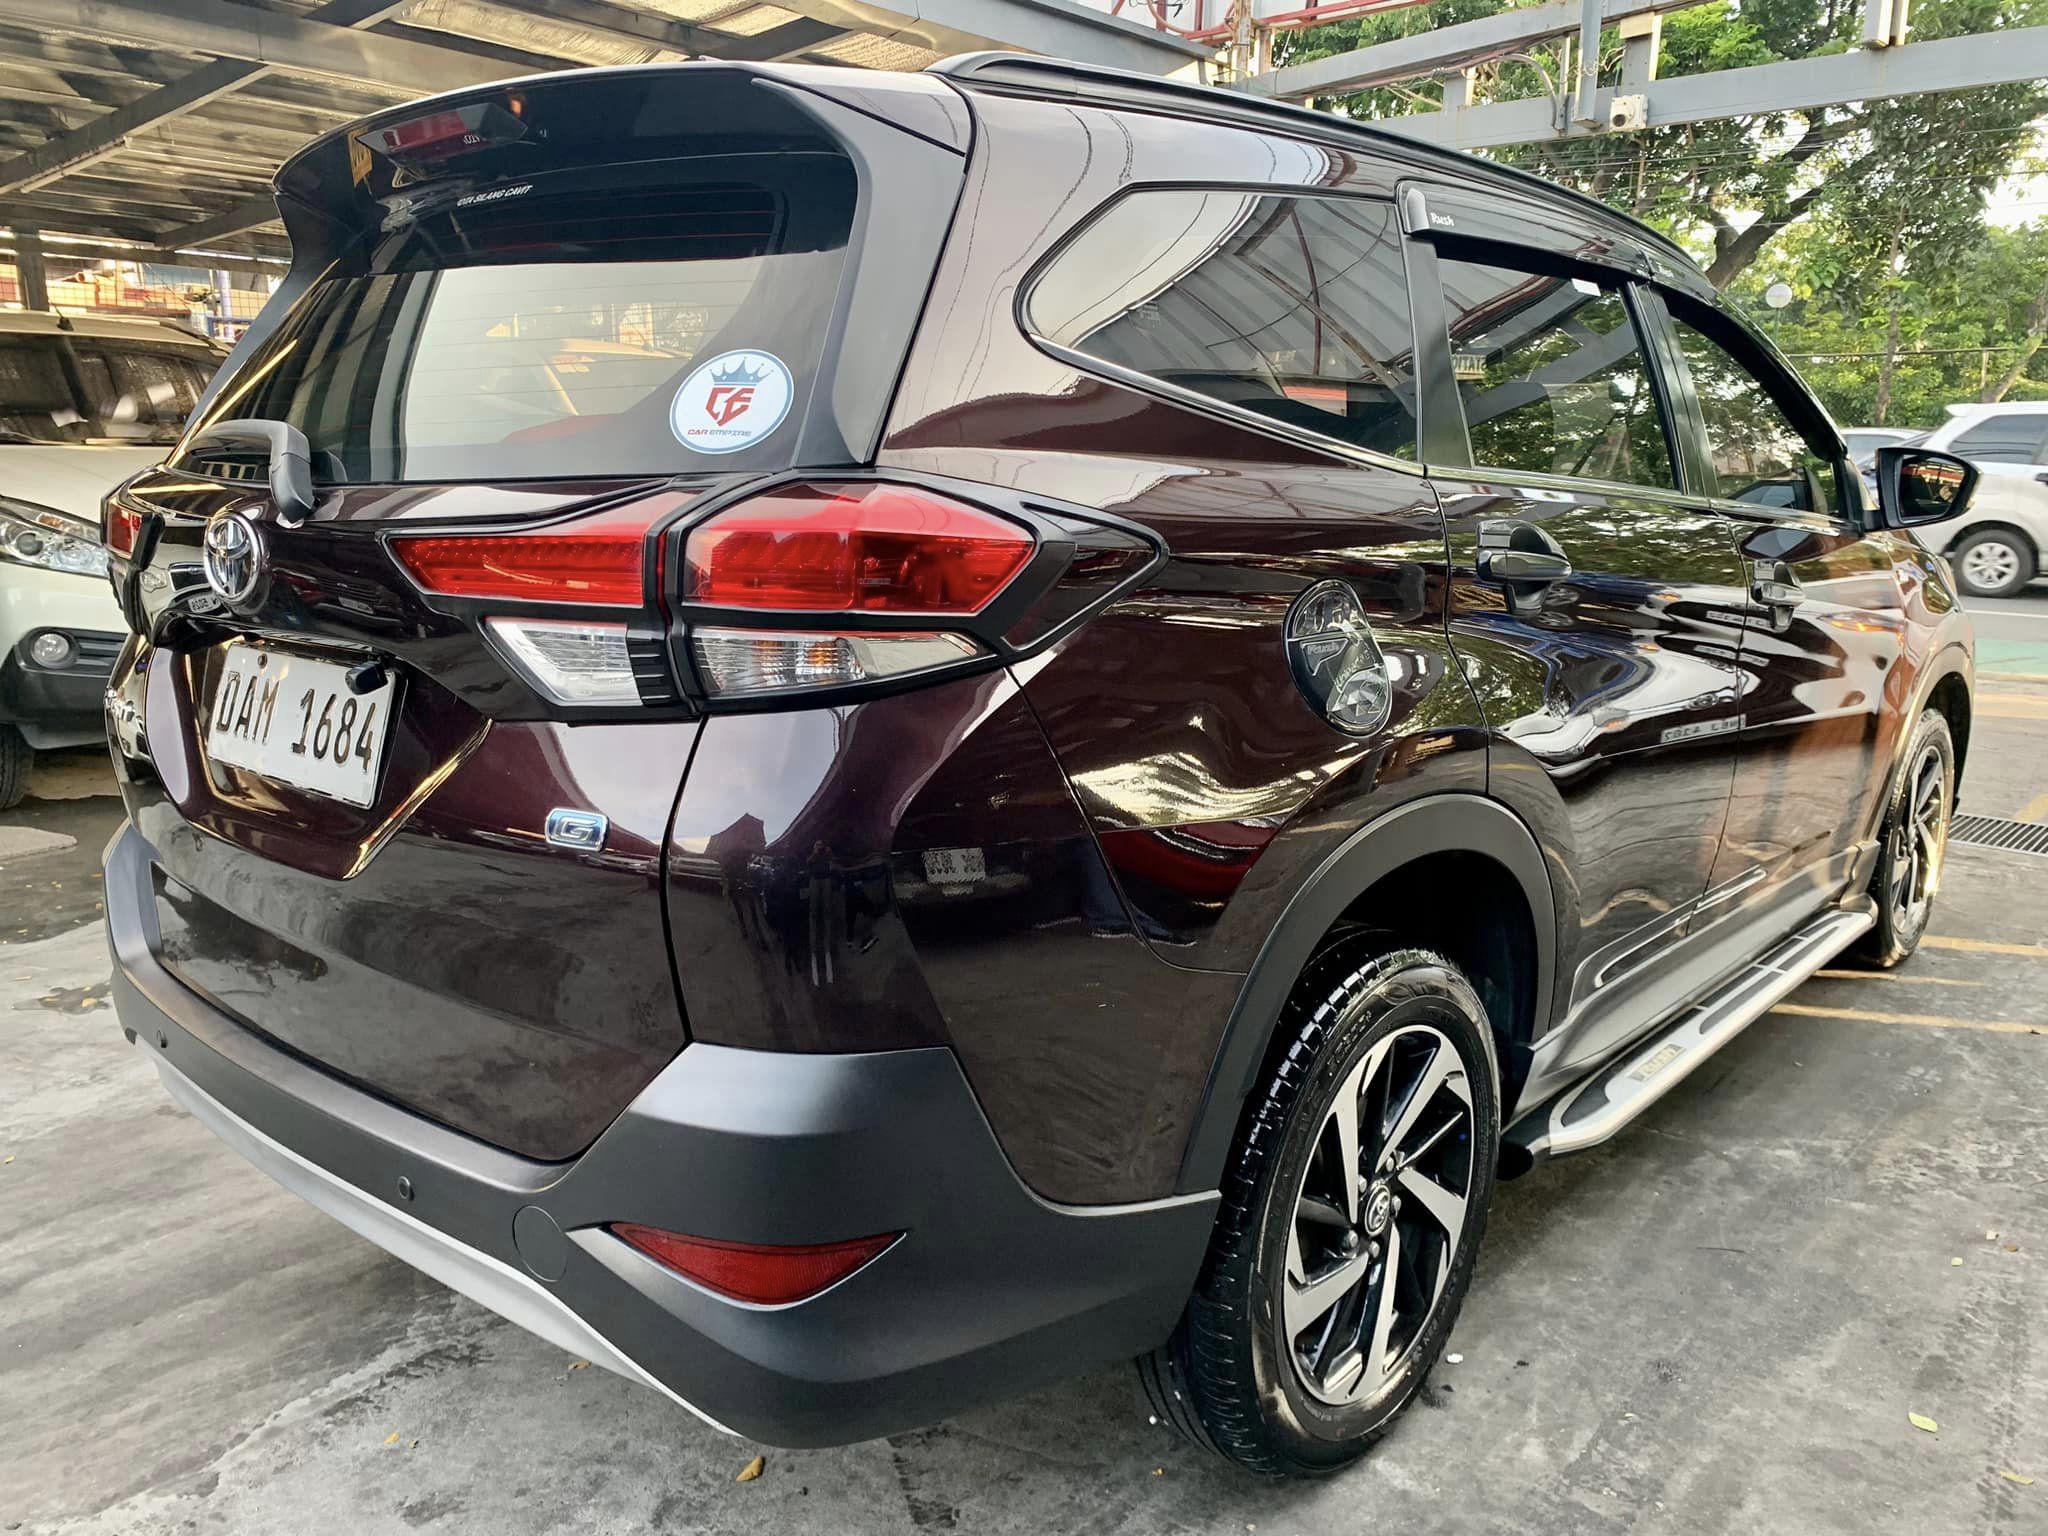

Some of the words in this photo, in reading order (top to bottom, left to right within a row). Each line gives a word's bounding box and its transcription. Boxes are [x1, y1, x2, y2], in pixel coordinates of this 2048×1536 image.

[1430, 212, 1455, 227] Rush
[709, 429, 752, 437] EMPIRE
[216, 671, 280, 744] DAM
[291, 688, 377, 773] 1684
[552, 816, 598, 842] G
